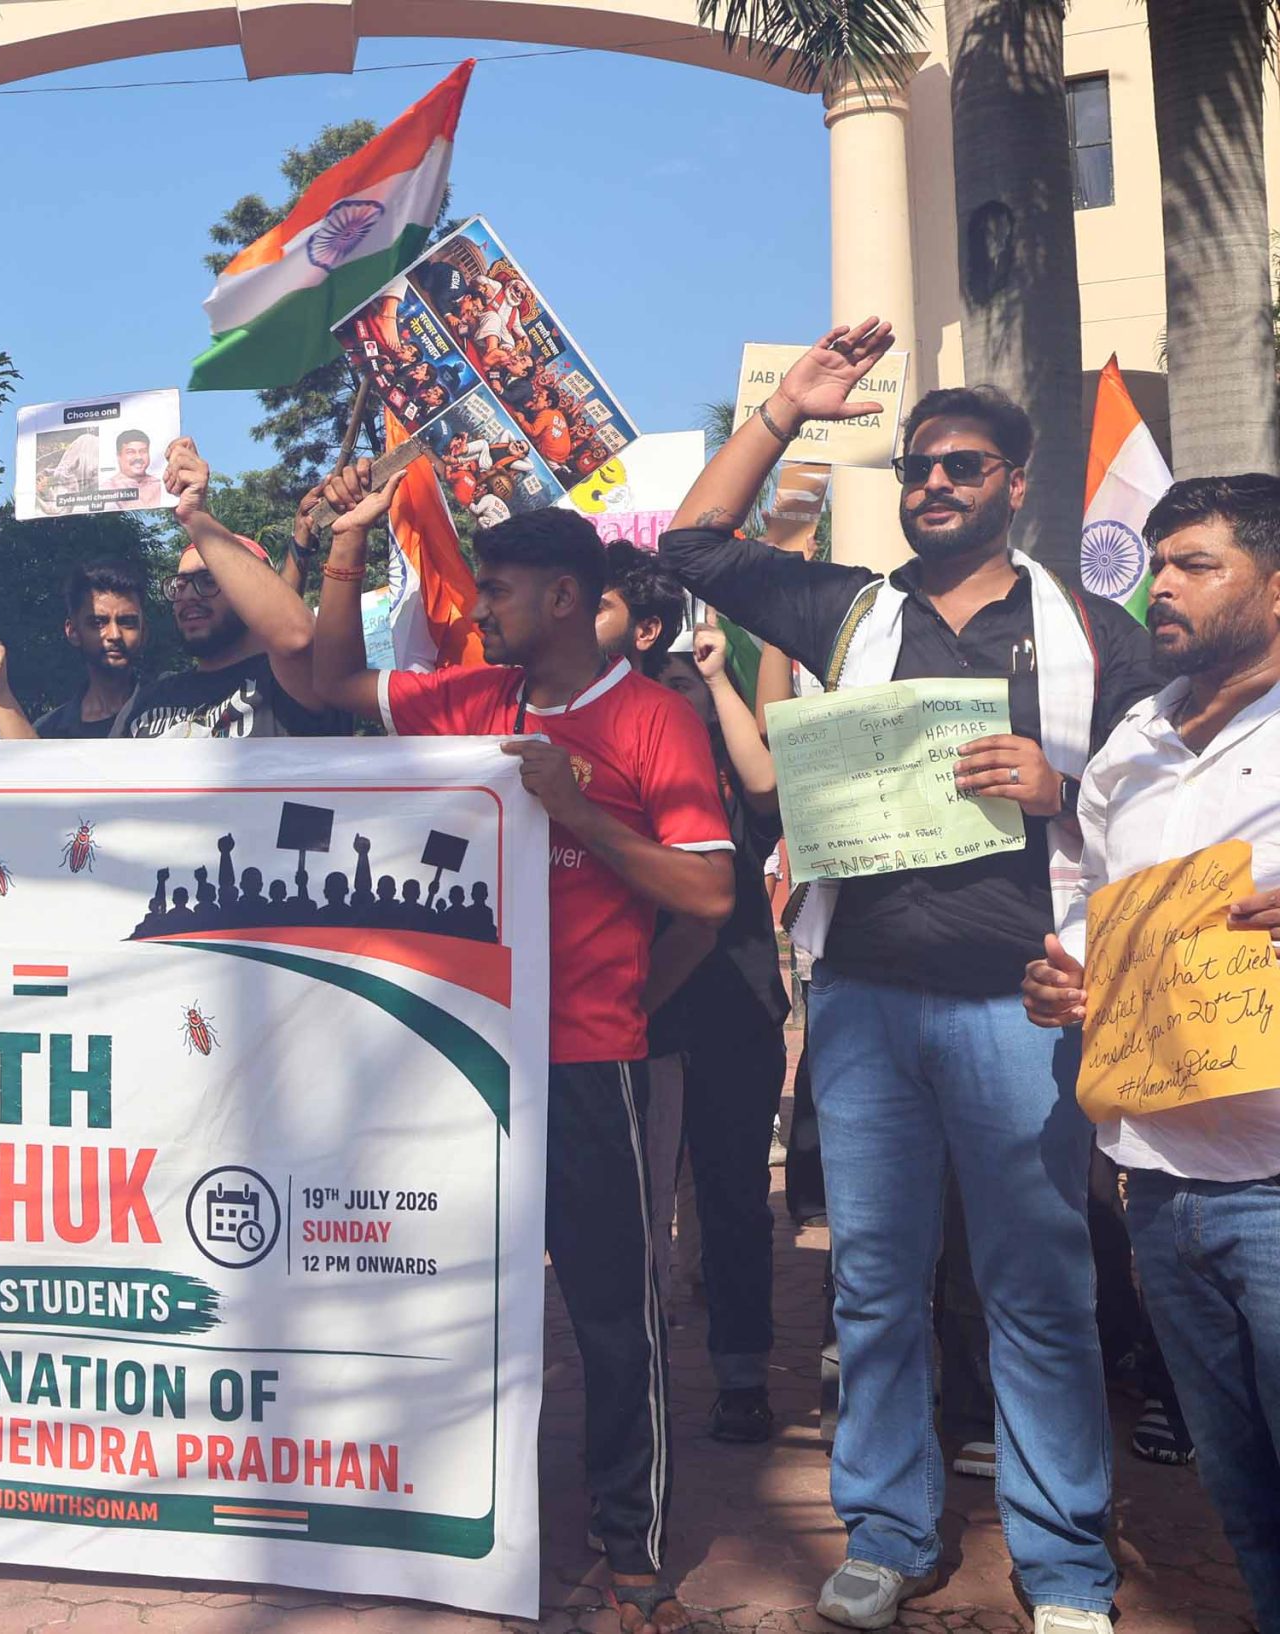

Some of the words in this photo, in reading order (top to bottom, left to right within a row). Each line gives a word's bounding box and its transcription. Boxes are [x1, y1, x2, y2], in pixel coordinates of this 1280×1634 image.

[748, 370, 775, 384] JAB
[66, 409, 100, 421] Choose
[101, 407, 118, 417] one
[922, 700, 963, 713] MODI
[872, 734, 883, 747] F
[926, 722, 987, 740] HAMARE
[876, 752, 885, 761] D
[799, 843, 820, 854] STOP
[898, 831, 911, 839] OUR
[549, 846, 586, 869] wer
[812, 850, 908, 878] INDIA
[936, 851, 948, 861] KE
[955, 843, 980, 856] BAAP
[985, 839, 997, 849] KA
[1157, 960, 1220, 994] what
[1227, 945, 1273, 976] died
[1228, 988, 1274, 1034] July
[302, 1188, 340, 1209] 19TH
[345, 1189, 391, 1211] JULY
[396, 1191, 438, 1211] 2026
[302, 1220, 392, 1243] SUNDAY
[302, 1255, 320, 1272] 12
[326, 1255, 350, 1272] PM
[357, 1256, 437, 1276] ONWARDS
[0, 1277, 171, 1322] STUDENTS
[209, 1369, 280, 1423] OF
[177, 1434, 416, 1496] PRADHAN.
